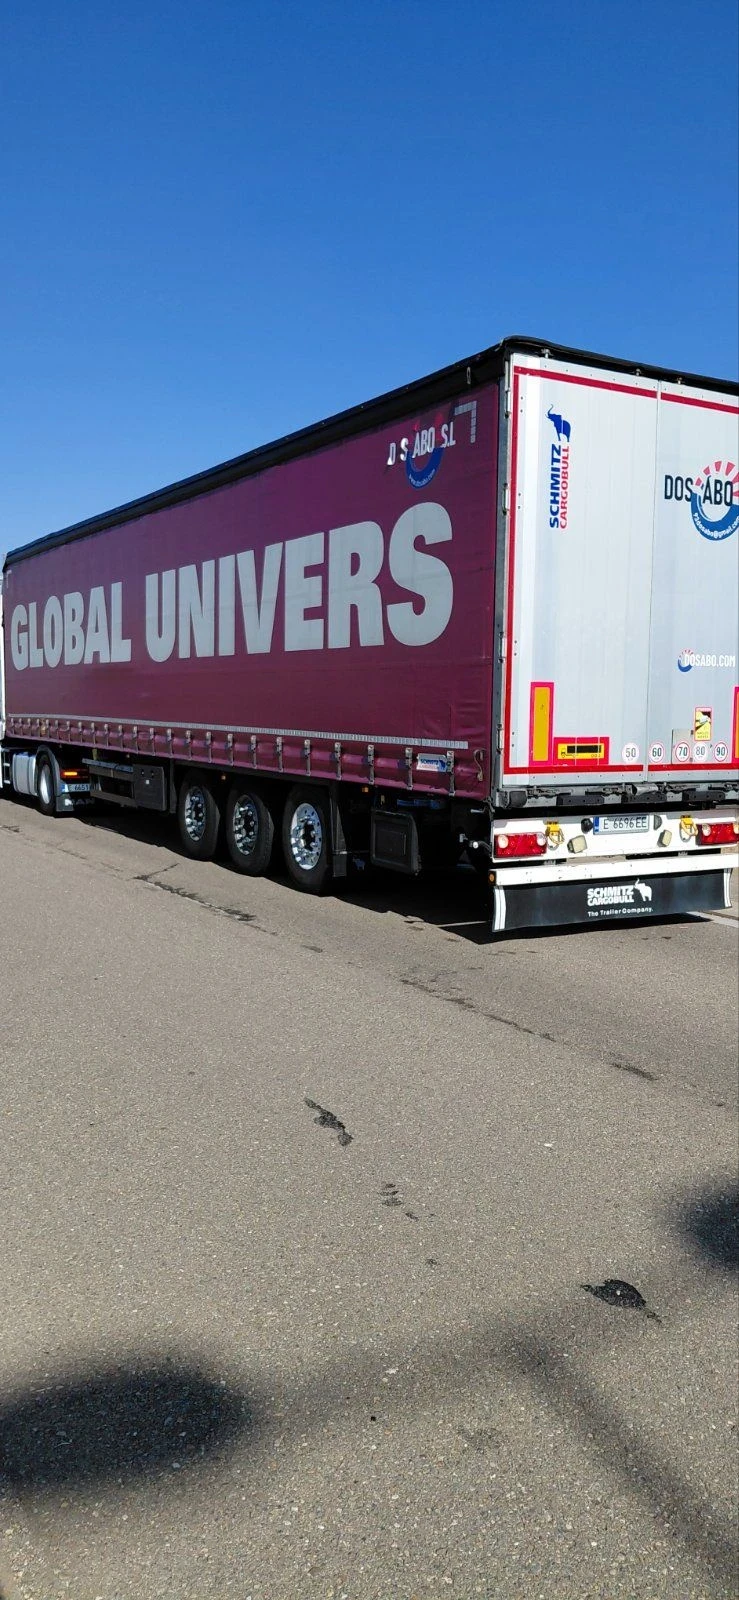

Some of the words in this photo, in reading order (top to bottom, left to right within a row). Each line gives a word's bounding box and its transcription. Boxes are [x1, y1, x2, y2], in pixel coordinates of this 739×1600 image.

[549, 443, 562, 529] SCHMITZ
[560, 446, 570, 530] CARGOBULL
[10, 581, 132, 671] GLOBAL
[145, 501, 454, 663] UNIVERS
[684, 653, 736, 668] DOSABO.COM
[625, 747, 637, 758] 50
[651, 747, 662, 757] 60
[678, 746, 688, 757] 70
[695, 745, 705, 756] 80
[715, 746, 726, 757] 90
[613, 817, 635, 829] 6696
[635, 816, 647, 828] EE
[586, 885, 634, 899] SCHMITZ
[586, 894, 635, 907] CARGOBULL
[621, 906, 654, 915] Company.
